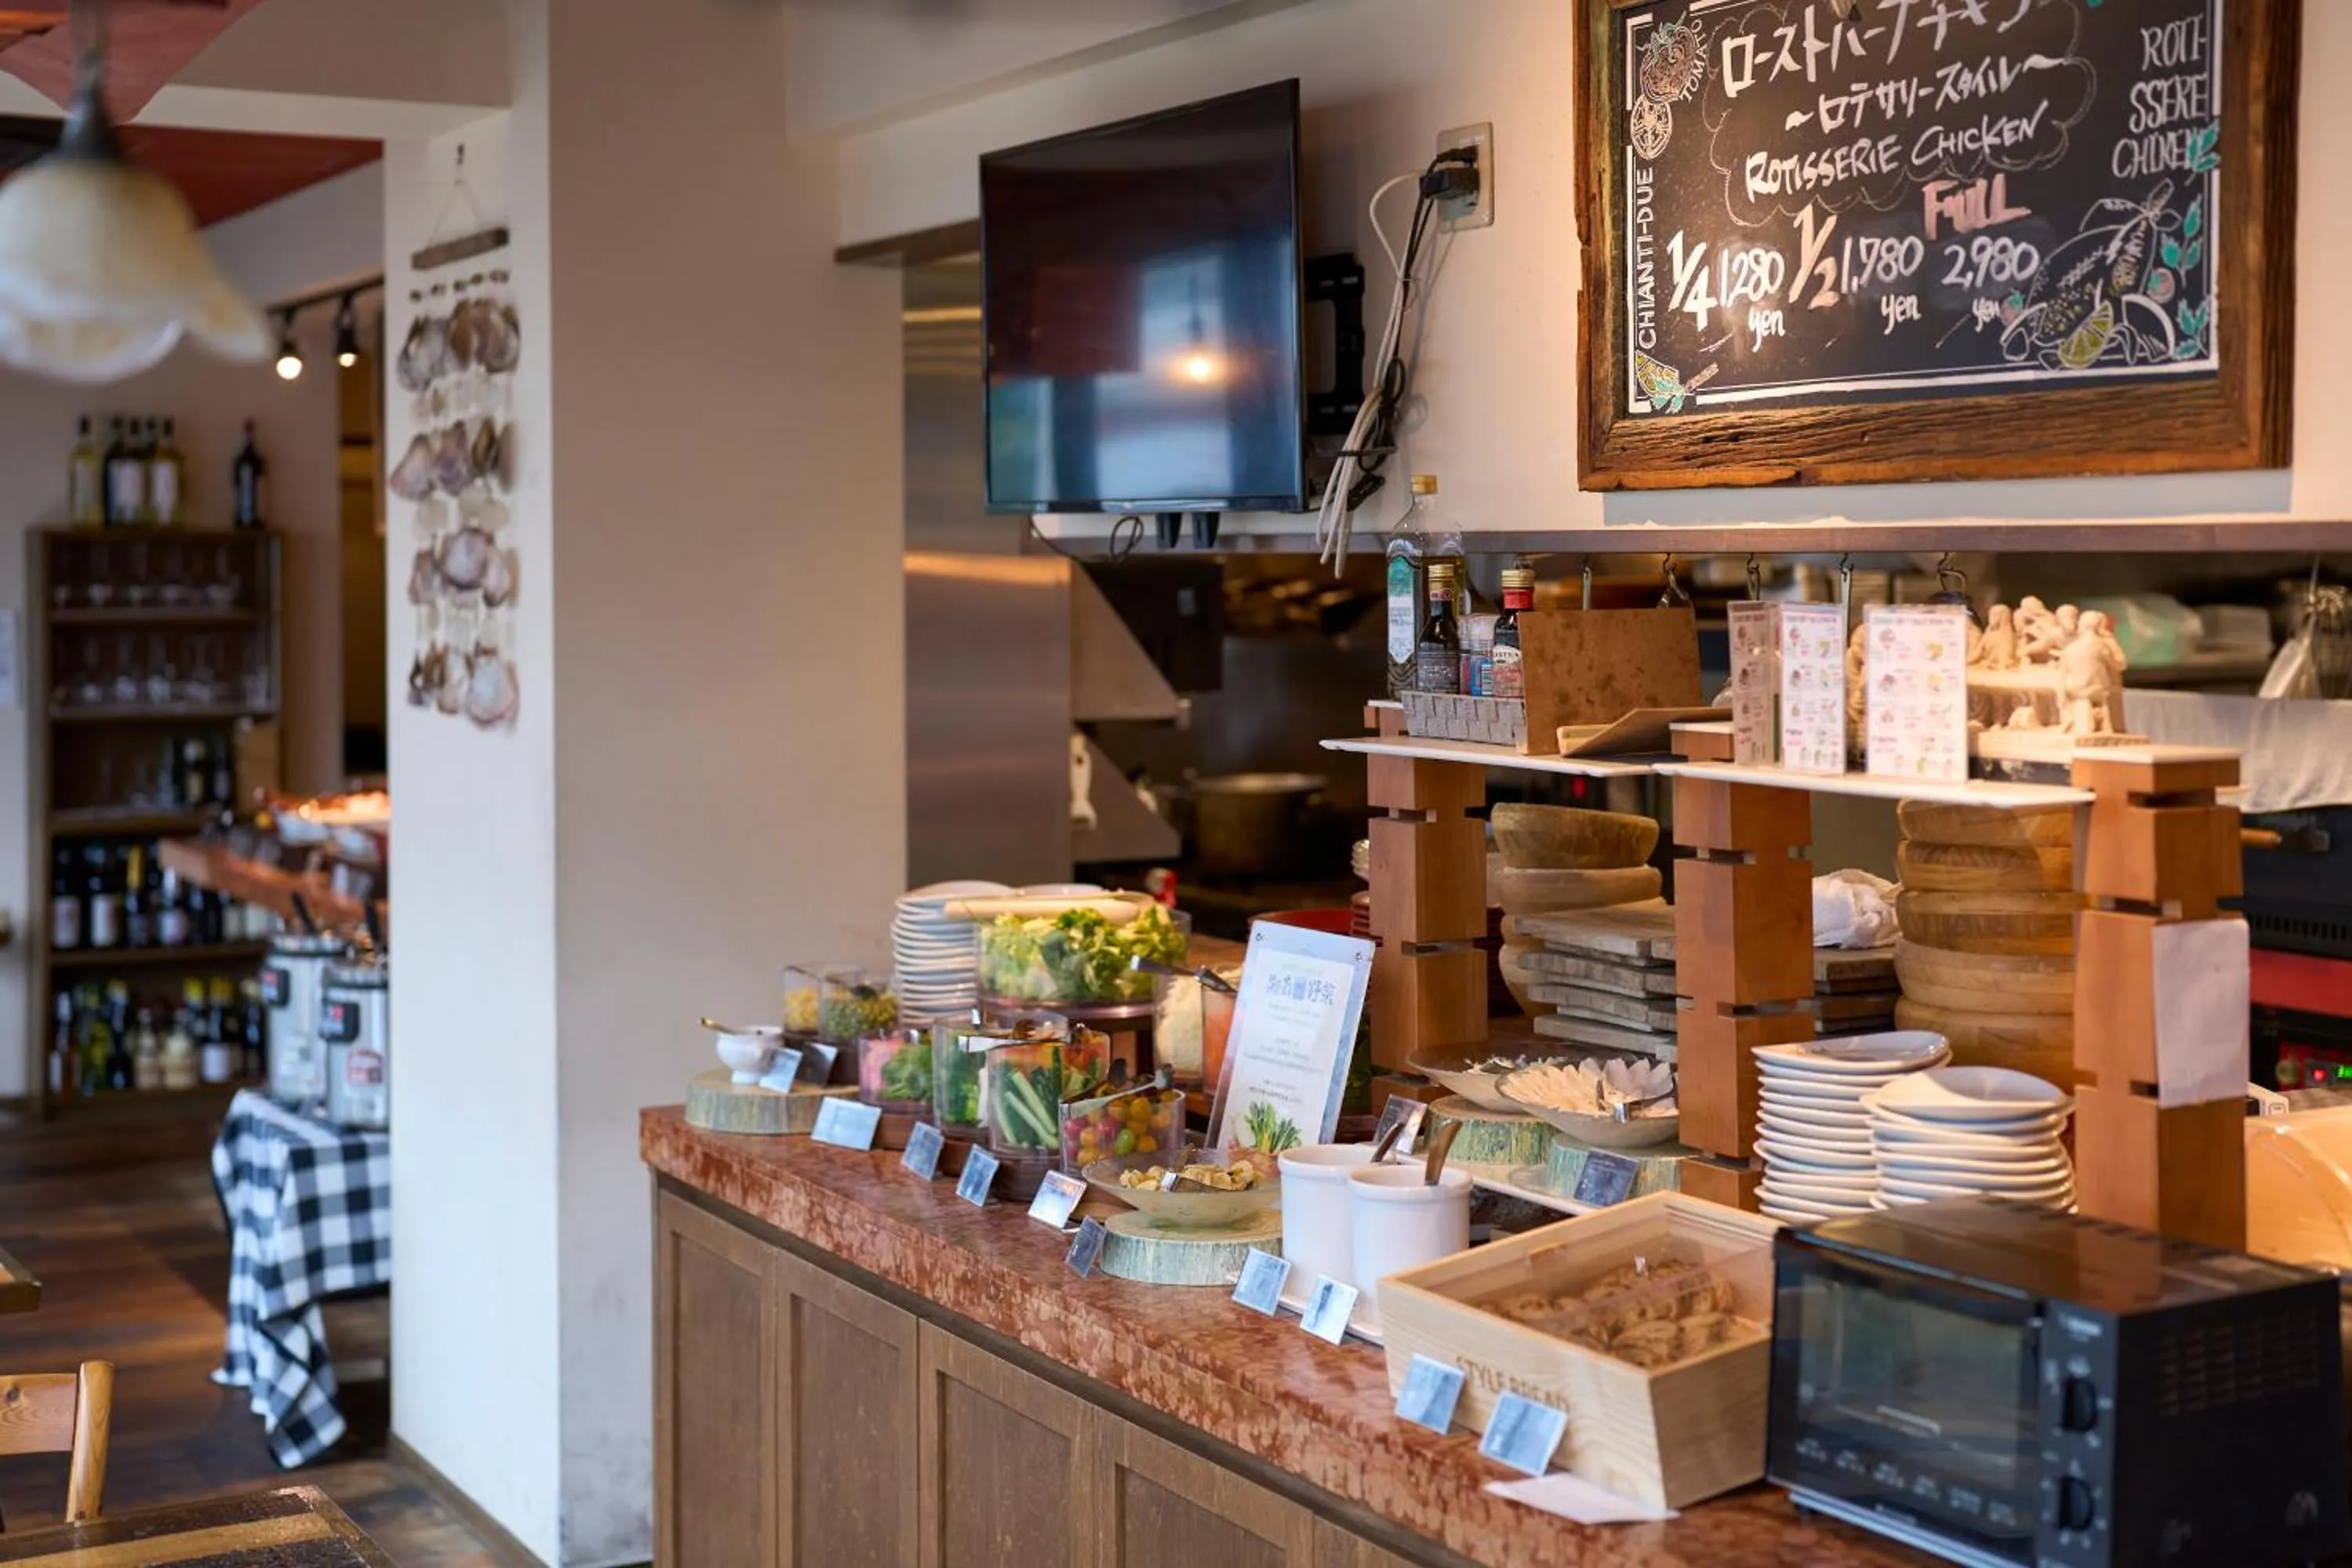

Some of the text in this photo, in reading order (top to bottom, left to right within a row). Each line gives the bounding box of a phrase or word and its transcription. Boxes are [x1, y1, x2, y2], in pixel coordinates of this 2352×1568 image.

[1679, 19, 1708, 103] TOMATO
[1745, 99, 2049, 204] ROTISSERIE CHICKEN
[1635, 166, 1657, 350] CHIANTI-DUE
[1941, 235, 2040, 292] 2,980
[1748, 308, 1786, 353] yen
[1881, 293, 1922, 336] yen
[1972, 296, 2001, 333] yen
